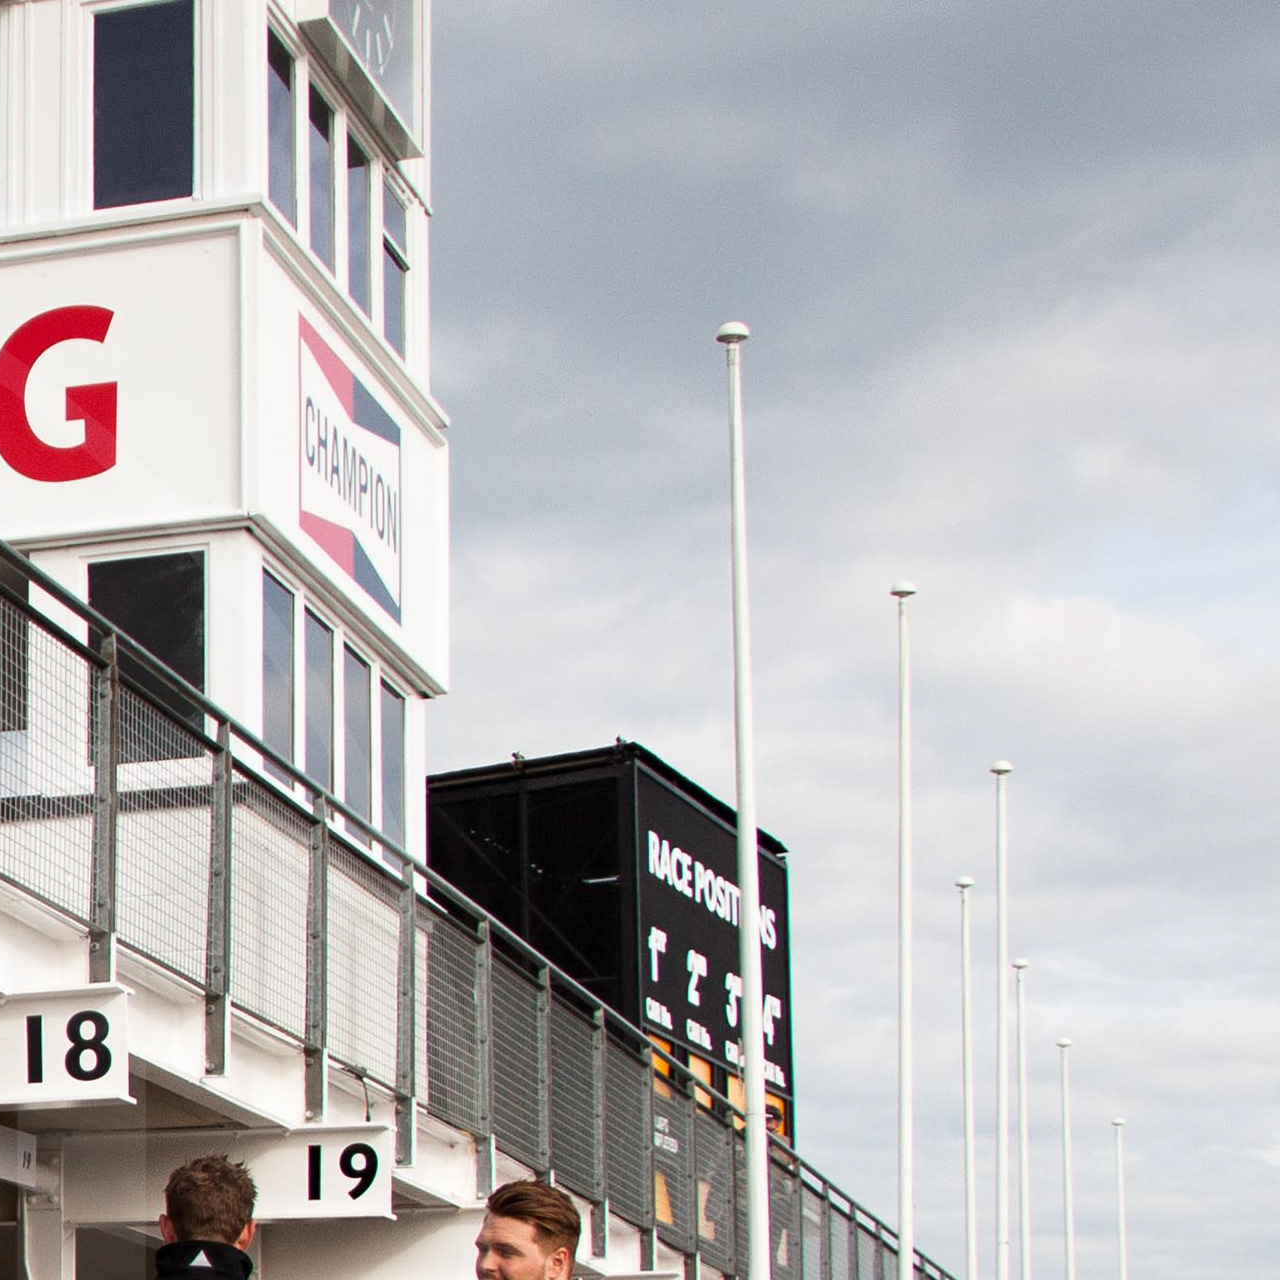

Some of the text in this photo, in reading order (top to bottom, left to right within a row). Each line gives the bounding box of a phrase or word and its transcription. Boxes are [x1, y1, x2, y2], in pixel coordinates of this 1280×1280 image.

[304, 395, 398, 553] CHAMPION
[647, 829, 777, 950] RACE POSITNS
[26, 1010, 113, 1085] 18
[308, 1142, 379, 1201] 19
